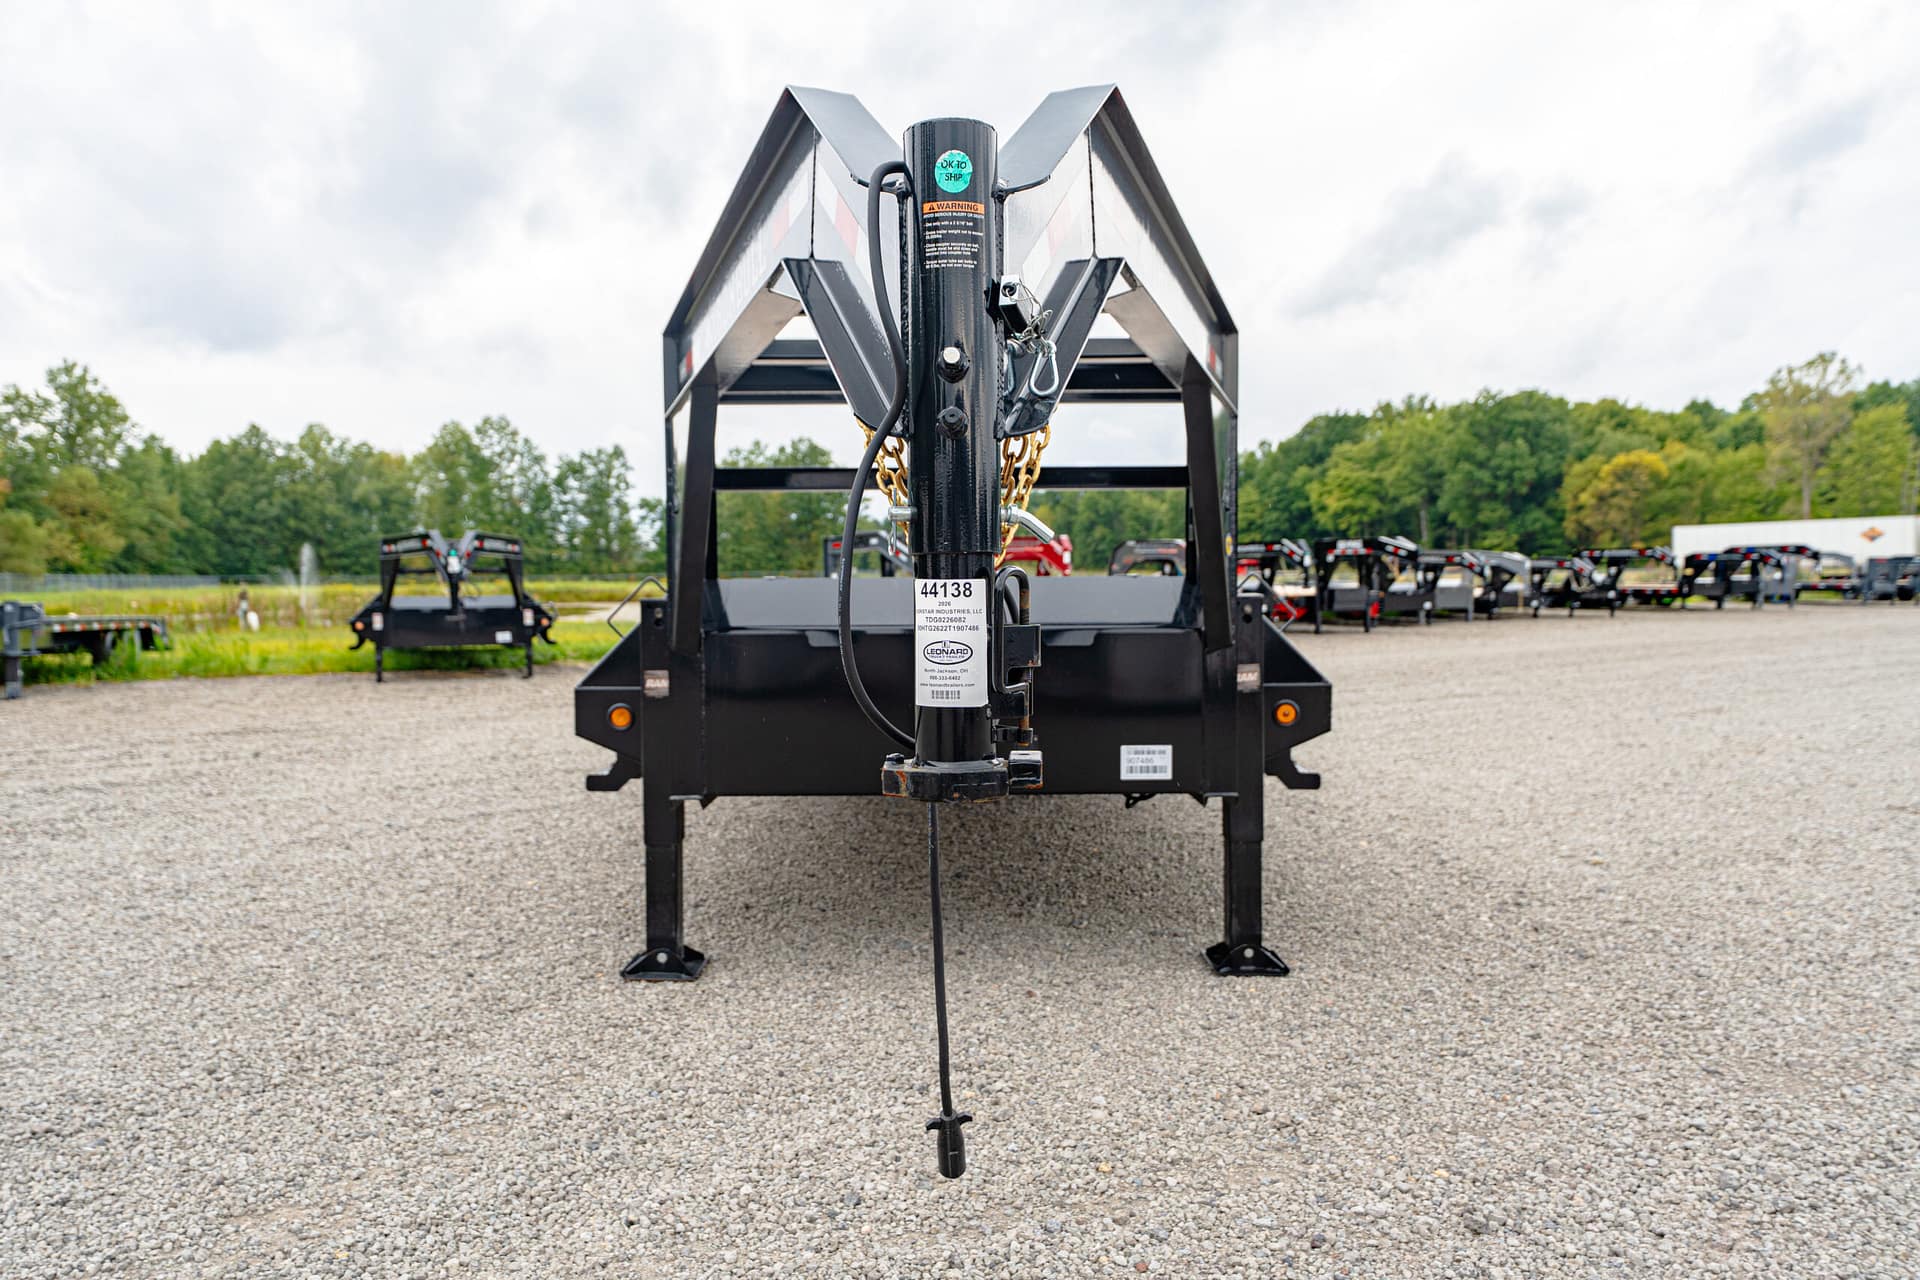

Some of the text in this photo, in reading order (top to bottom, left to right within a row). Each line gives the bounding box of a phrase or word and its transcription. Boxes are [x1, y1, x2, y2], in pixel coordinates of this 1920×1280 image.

[941, 160, 967, 169] OK TO
[944, 173, 963, 181] SHIP
[937, 202, 978, 211] WARNING
[920, 581, 972, 598] 44138
